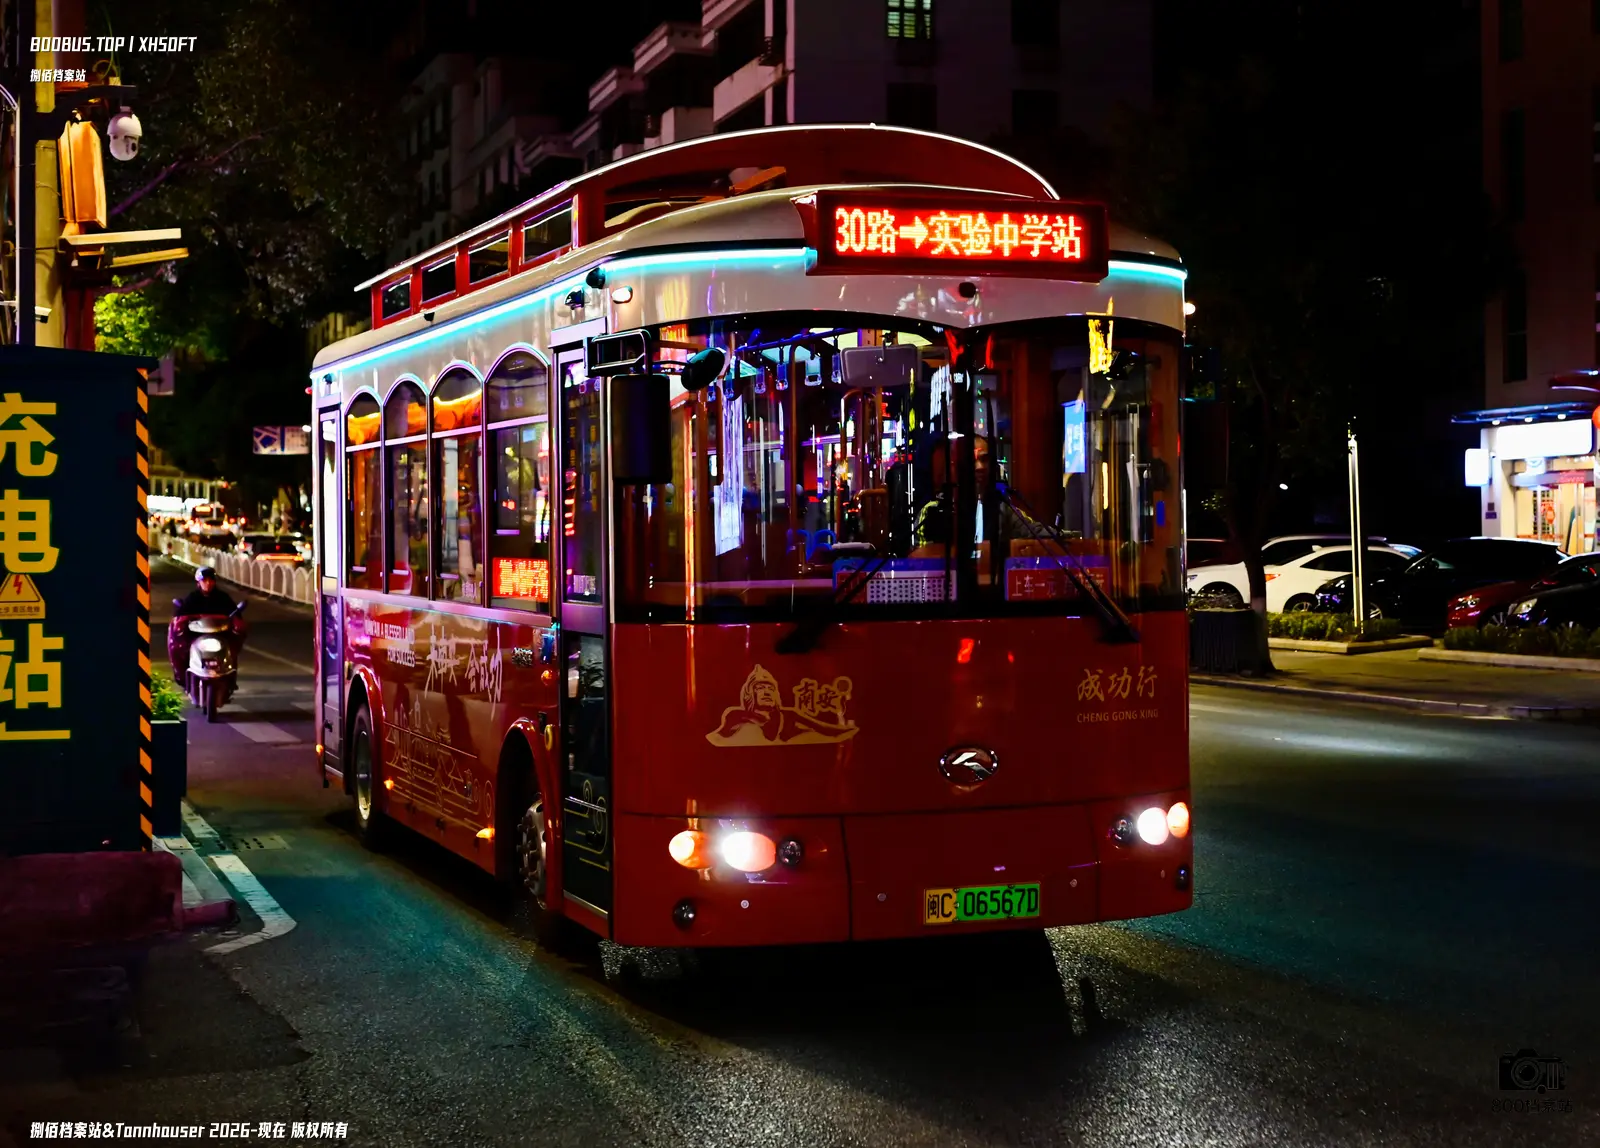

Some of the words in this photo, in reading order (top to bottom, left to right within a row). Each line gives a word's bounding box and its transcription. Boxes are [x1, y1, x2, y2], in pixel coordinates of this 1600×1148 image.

[835, 207, 899, 254] 30路
[928, 210, 1082, 259] 实验中学站
[1077, 666, 1158, 702] 成功行
[1077, 712, 1109, 723] CHENG
[1112, 710, 1138, 721] GONG
[963, 888, 1038, 917] 06567D
